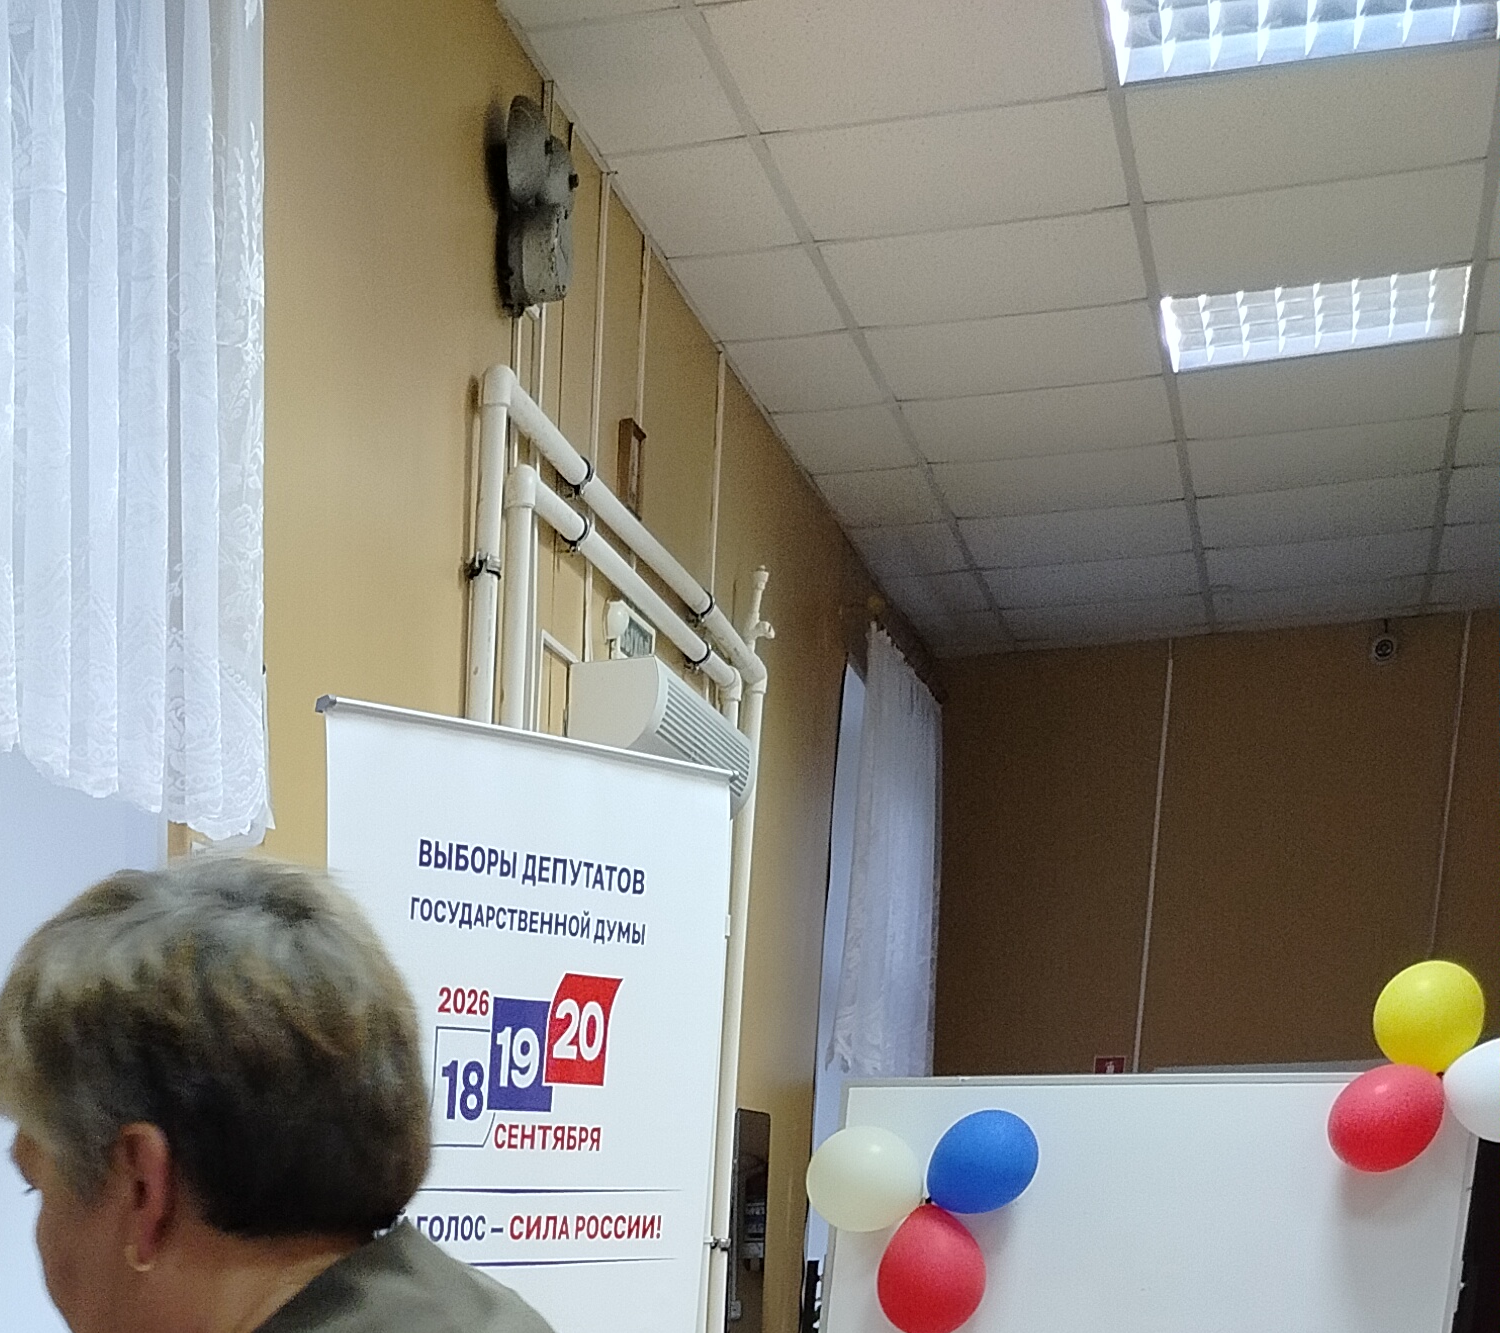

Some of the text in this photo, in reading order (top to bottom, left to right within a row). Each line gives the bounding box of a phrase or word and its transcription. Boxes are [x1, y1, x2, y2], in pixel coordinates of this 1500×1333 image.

[418, 838, 646, 895] ВЫБОРЫ ДЕПУТАТОВ
[410, 896, 646, 945] ГОСУДАРСТВЕННОЙ ДУМЫ
[437, 986, 490, 1017] 2026
[441, 998, 605, 1121] 18 19 20
[493, 1123, 602, 1151] СЕНТЯБРЯ
[417, 1215, 487, 1242] ГОЛОС
[509, 1214, 570, 1241] СИЛА
[575, 1214, 662, 1241] РОССИИ!
